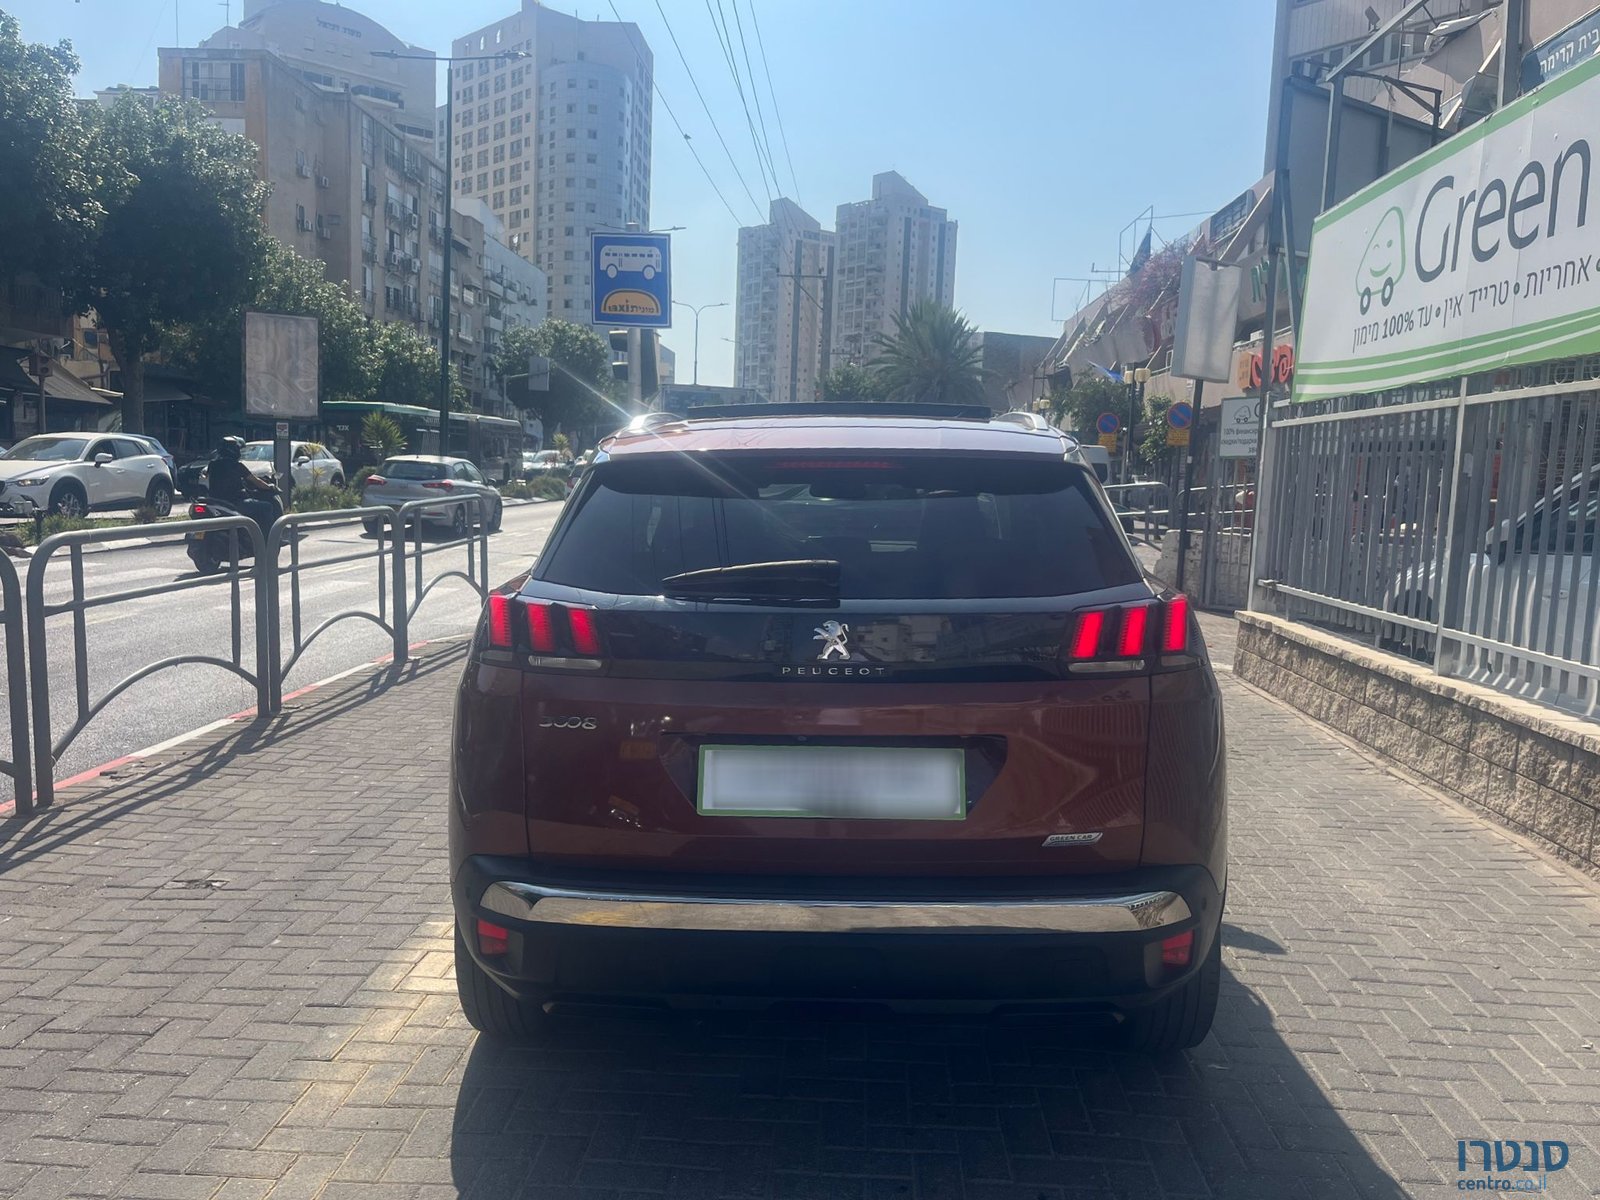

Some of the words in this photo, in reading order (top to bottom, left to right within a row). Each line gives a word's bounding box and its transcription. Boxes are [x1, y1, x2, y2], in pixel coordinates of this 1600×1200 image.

[1578, 28, 1599, 53] בית
[1414, 138, 1592, 283] Green
[1523, 254, 1592, 299] אחריות
[607, 299, 629, 312] taxi
[630, 304, 655, 313] מונית
[1469, 279, 1510, 313] טרייד
[1417, 304, 1433, 328] עד
[1443, 293, 1464, 328] אין
[1352, 321, 1379, 354] מימון
[1382, 310, 1414, 339] 100%
[781, 667, 885, 675] PEUGEOT
[538, 715, 597, 730] 3008
